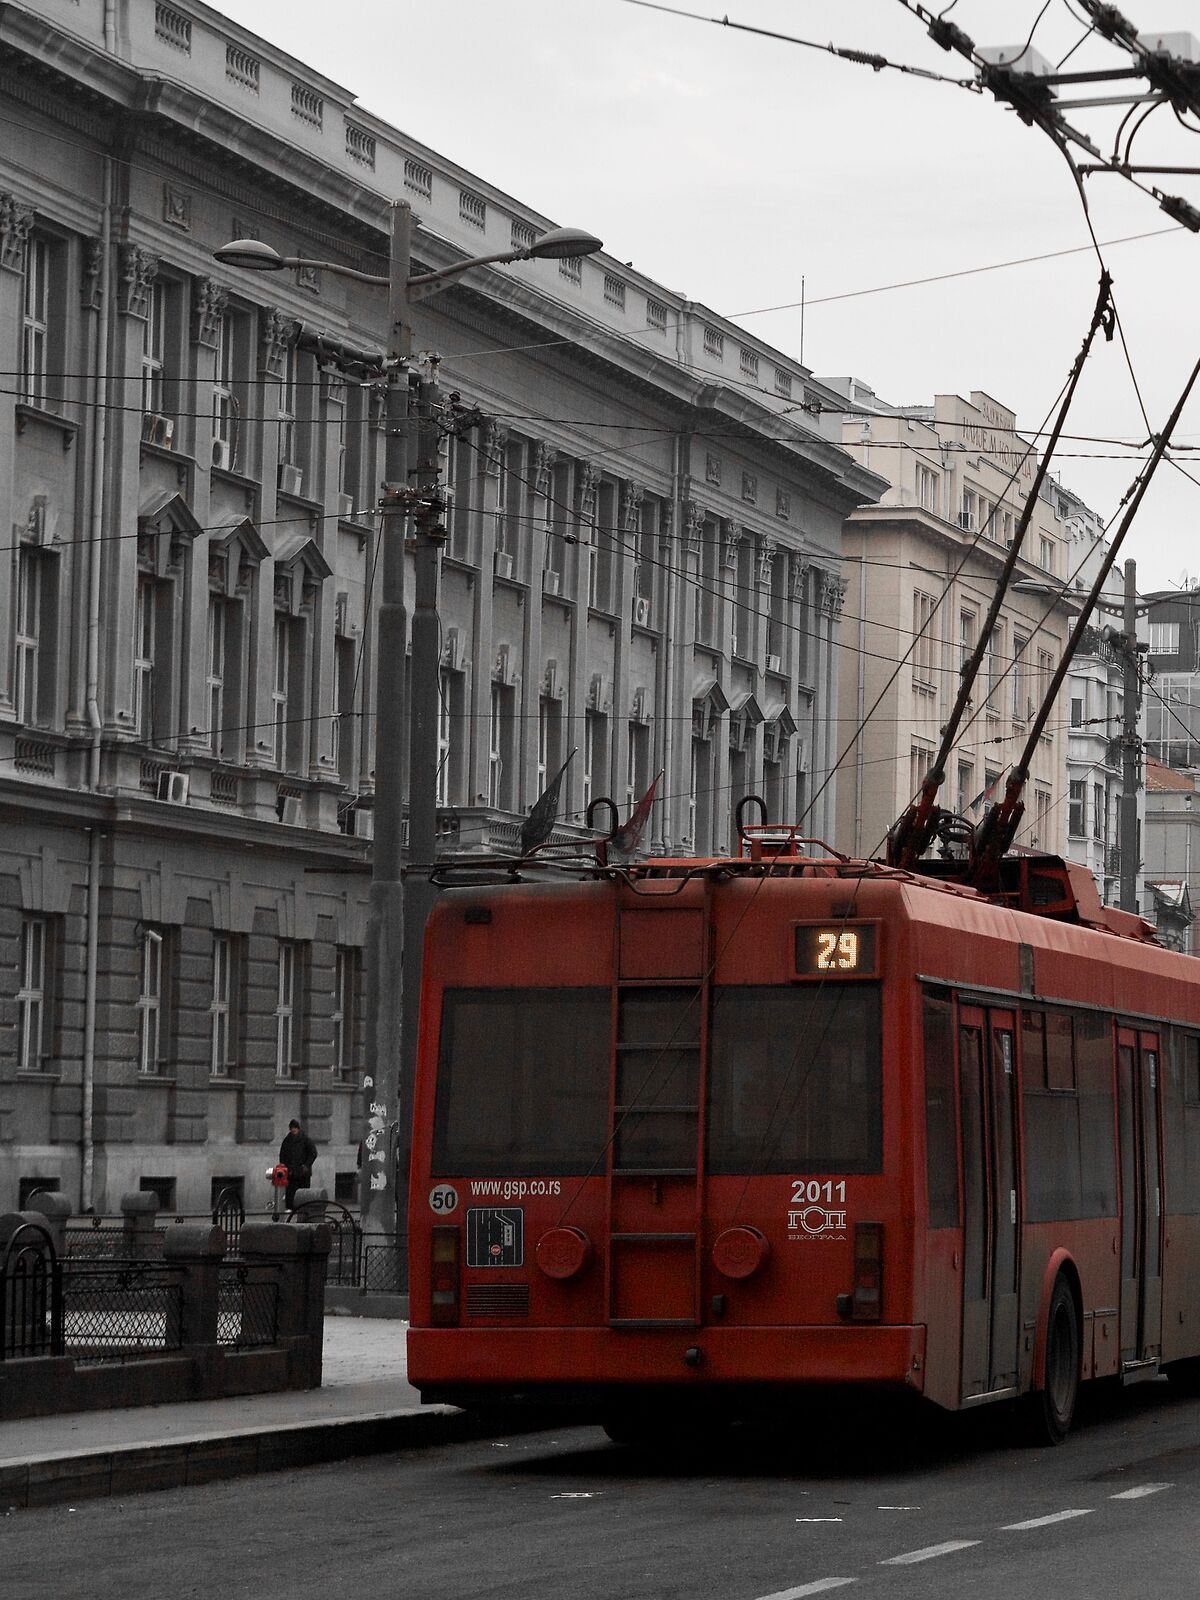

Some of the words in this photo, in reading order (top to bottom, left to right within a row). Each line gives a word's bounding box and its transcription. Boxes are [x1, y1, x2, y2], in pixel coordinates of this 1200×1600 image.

[818, 933, 857, 968] 29
[432, 1190, 456, 1210] 50
[470, 1180, 561, 1200] www.gsp.co.rs
[790, 1180, 847, 1203] 2011
